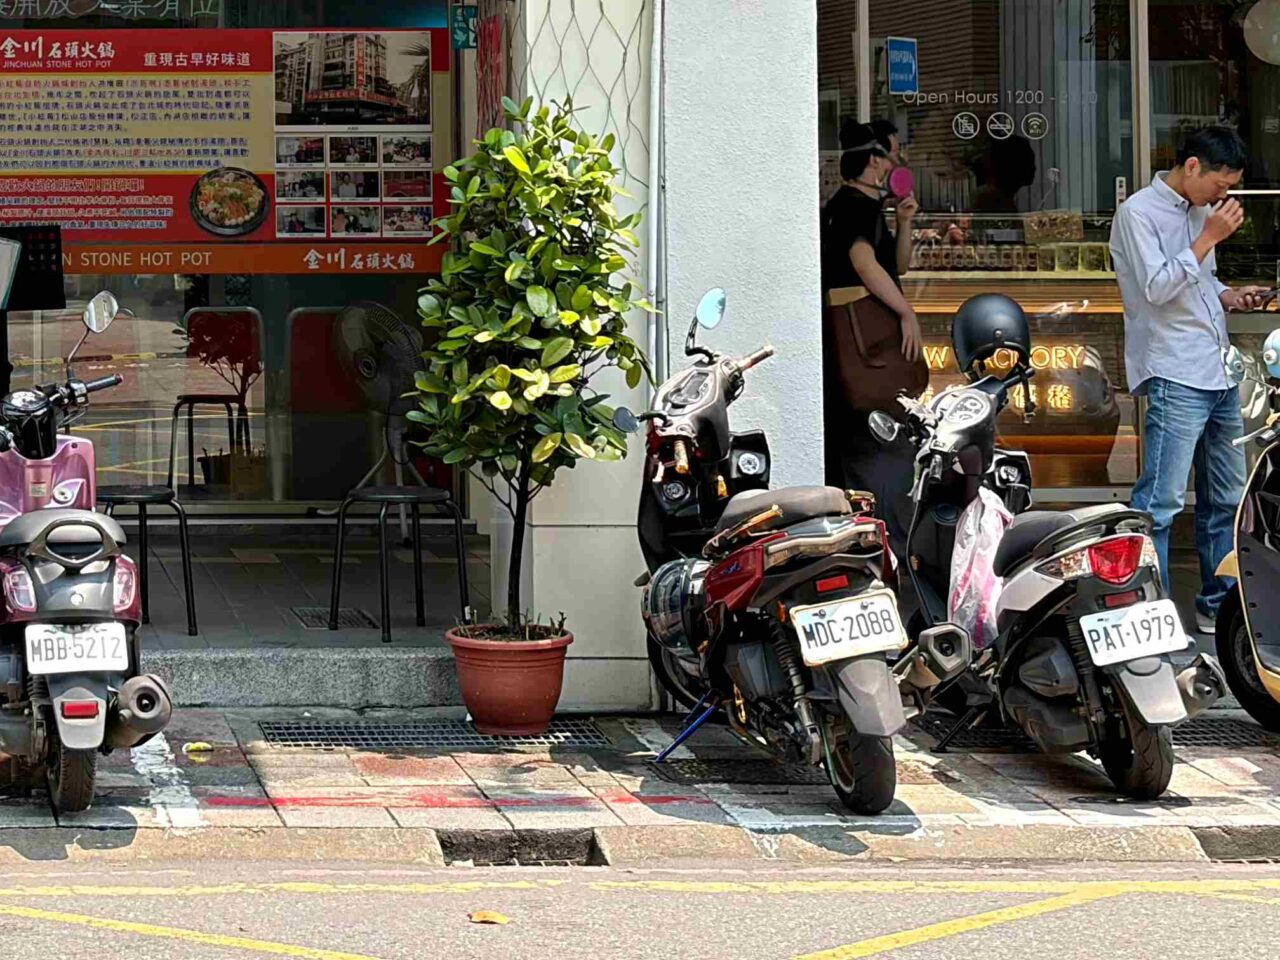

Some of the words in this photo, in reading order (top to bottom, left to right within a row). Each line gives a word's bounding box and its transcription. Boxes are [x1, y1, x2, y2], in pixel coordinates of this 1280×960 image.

[0, 35, 116, 59] 金川石頭火鍋
[2, 60, 43, 69] JINCHUAN
[46, 60, 73, 69] STONE
[75, 60, 93, 69] HOT
[95, 60, 112, 69] POT
[143, 52, 252, 67] 重現古早好味道
[902, 90, 949, 107] Open
[954, 90, 999, 104] Hours
[1006, 90, 1045, 104] 1200
[80, 251, 132, 266] STONE
[139, 251, 172, 266] HOT
[180, 251, 213, 266] POT
[303, 246, 416, 272] 金川石頭火鍋
